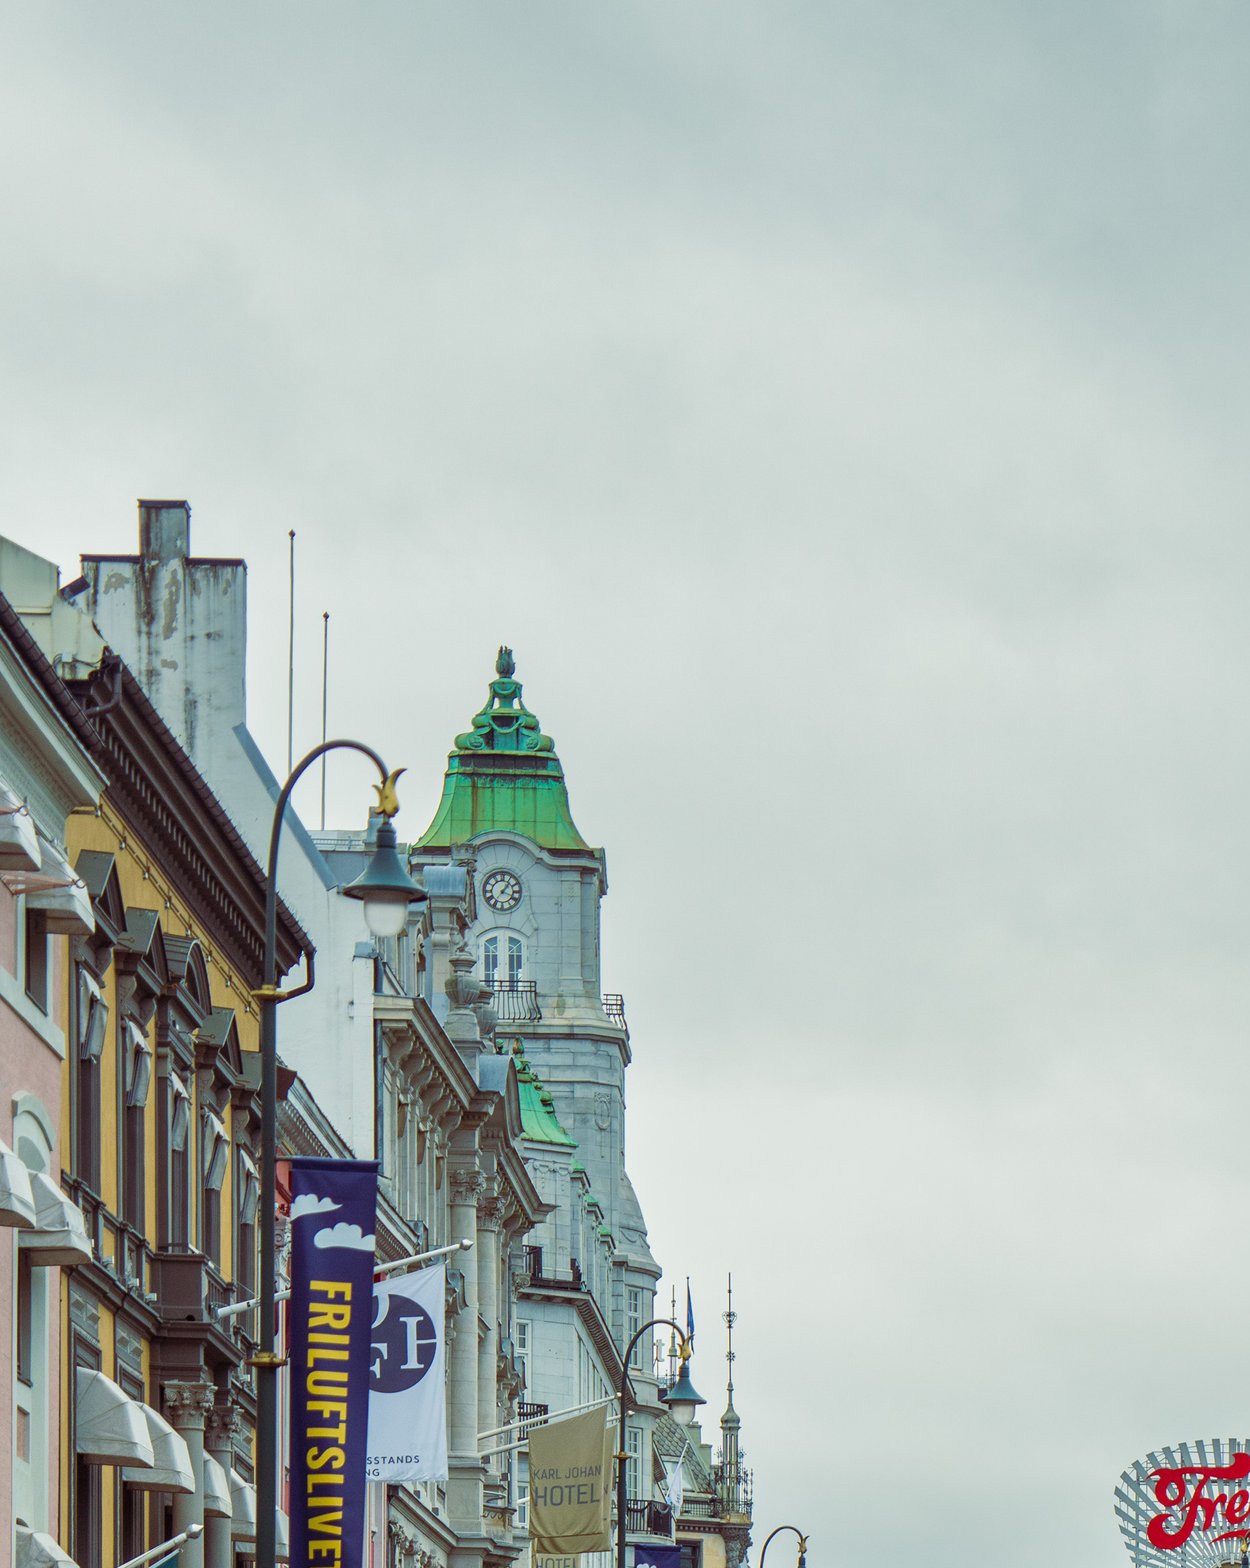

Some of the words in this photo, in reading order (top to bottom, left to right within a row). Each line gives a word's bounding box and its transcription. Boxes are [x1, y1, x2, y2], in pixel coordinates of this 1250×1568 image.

[533, 1468, 562, 1480] KARL
[564, 1465, 601, 1479] JOHAN
[534, 1483, 601, 1507] HOTEL
